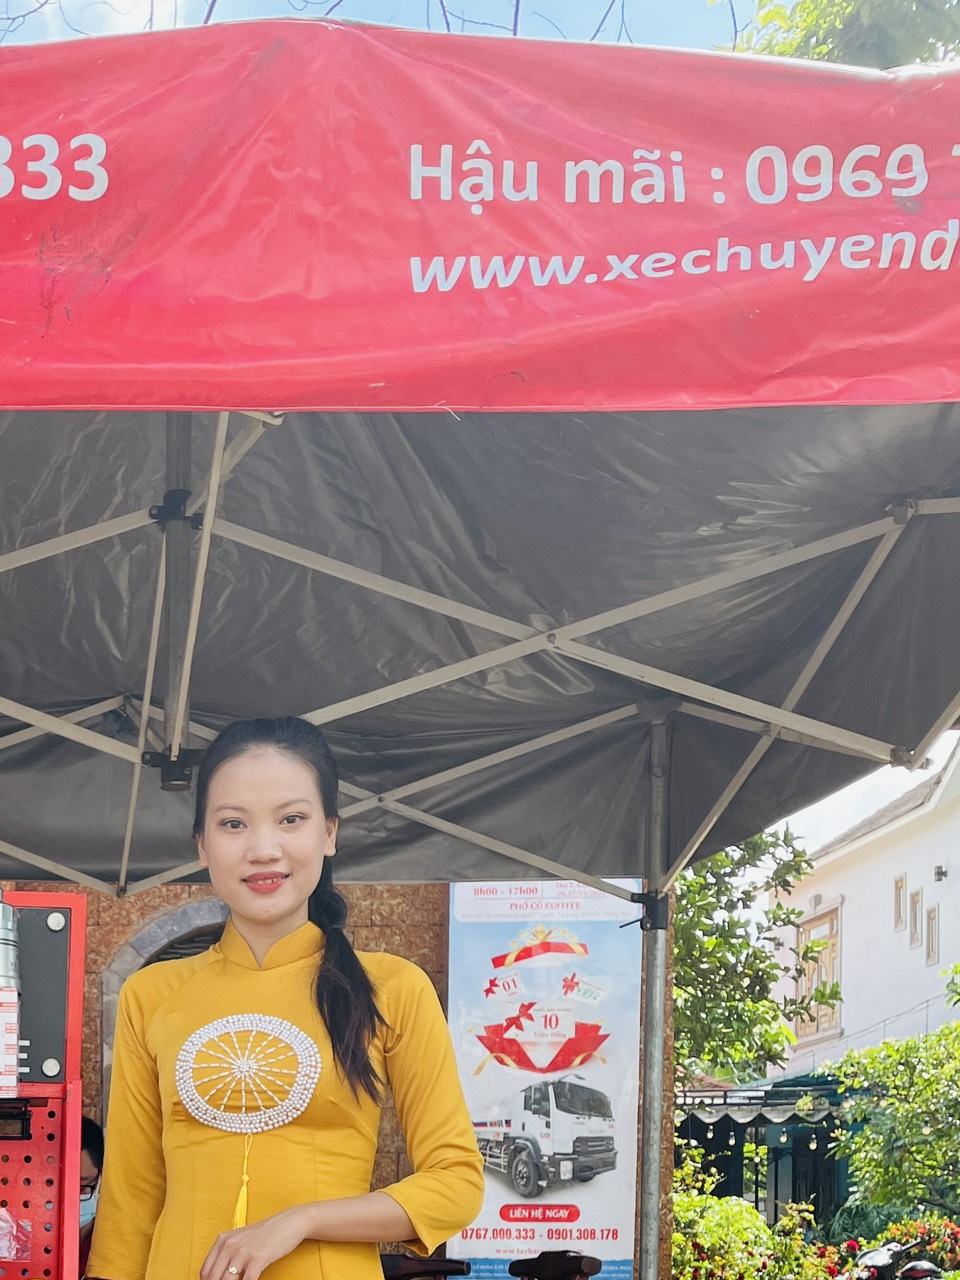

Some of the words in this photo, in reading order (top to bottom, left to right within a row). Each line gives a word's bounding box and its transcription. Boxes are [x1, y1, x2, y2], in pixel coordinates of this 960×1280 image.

[410, 144, 537, 216] Hậu
[565, 149, 685, 204] mãi
[745, 144, 929, 204] 0969
[410, 218, 960, 293] www.xechuyend
[541, 1013, 559, 1030] 10
[545, 1208, 570, 1218] NGAY
